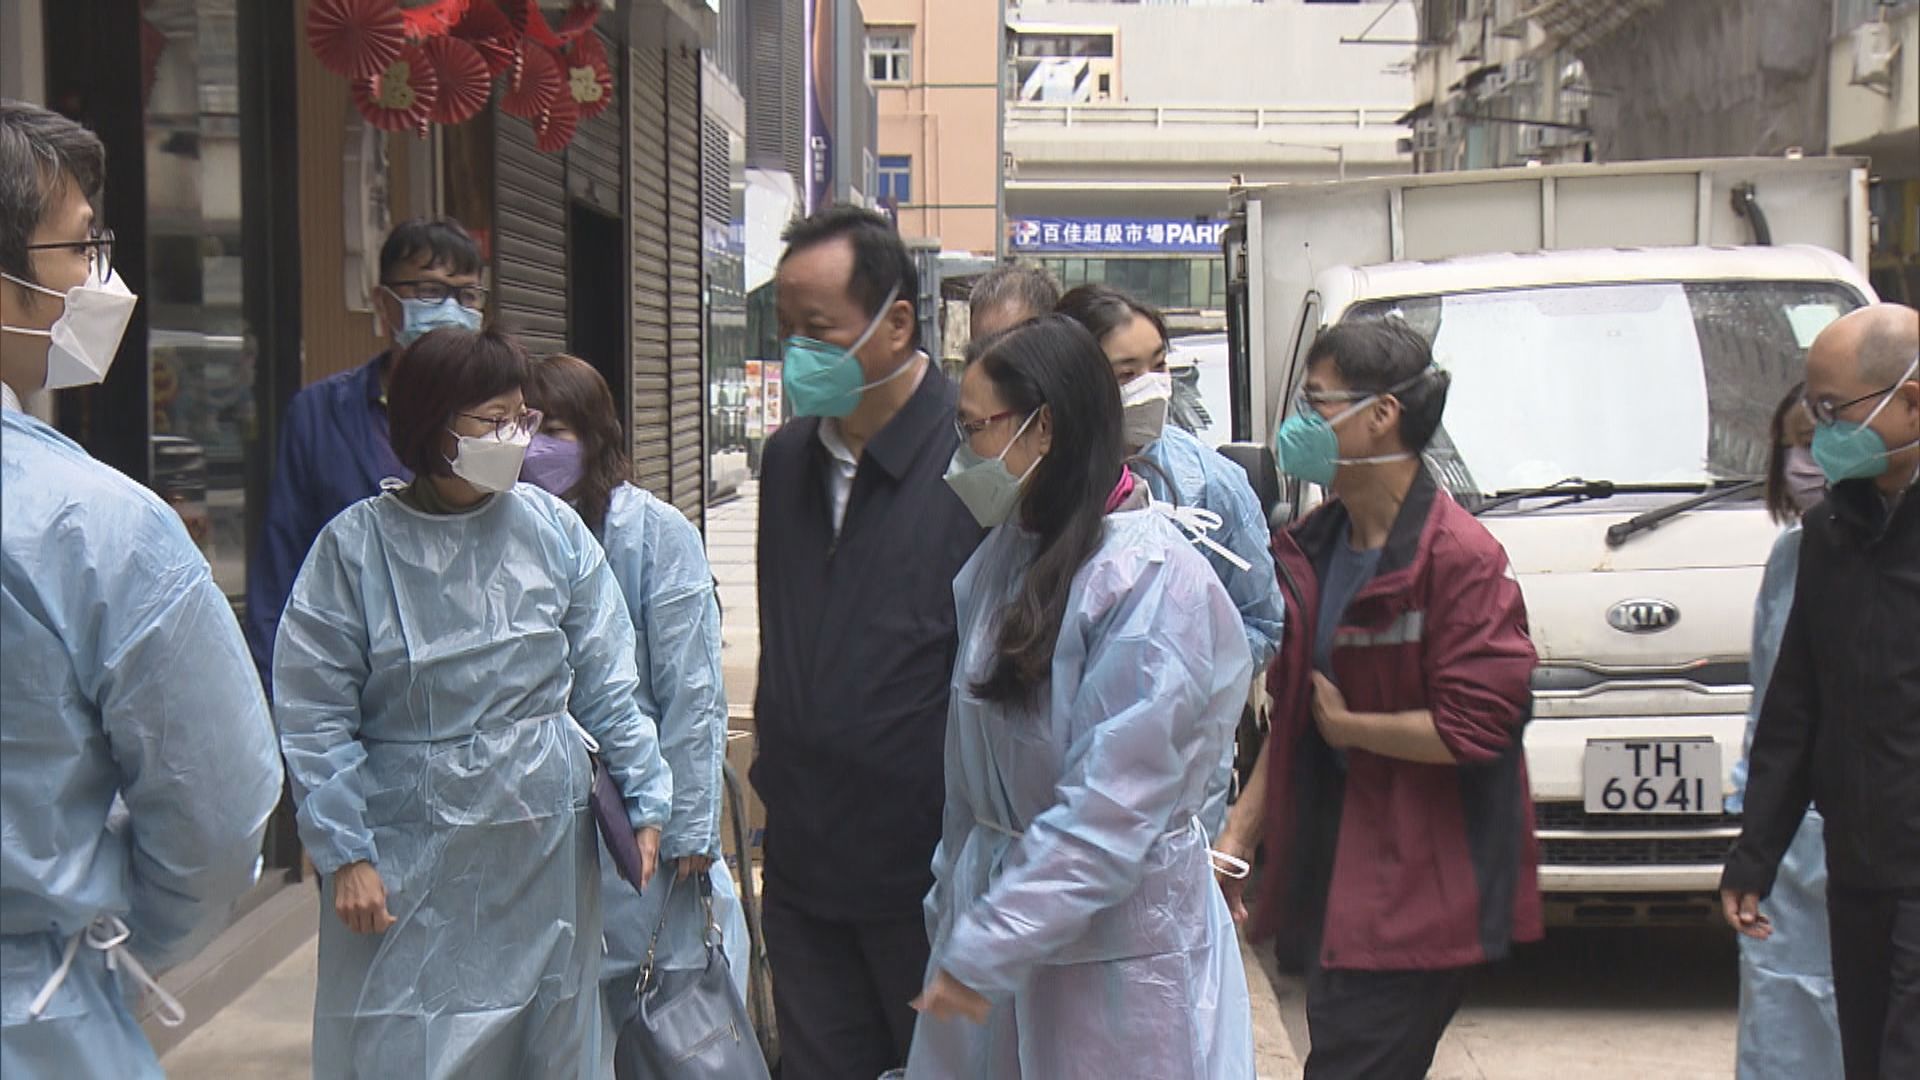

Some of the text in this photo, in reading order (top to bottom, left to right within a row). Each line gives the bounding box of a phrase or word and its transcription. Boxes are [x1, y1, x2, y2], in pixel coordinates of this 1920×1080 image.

[1043, 223, 1164, 244] 百佳超級市場
[1620, 605, 1667, 625] KIA
[1625, 744, 1681, 777] TH
[1603, 778, 1702, 811] 6641
